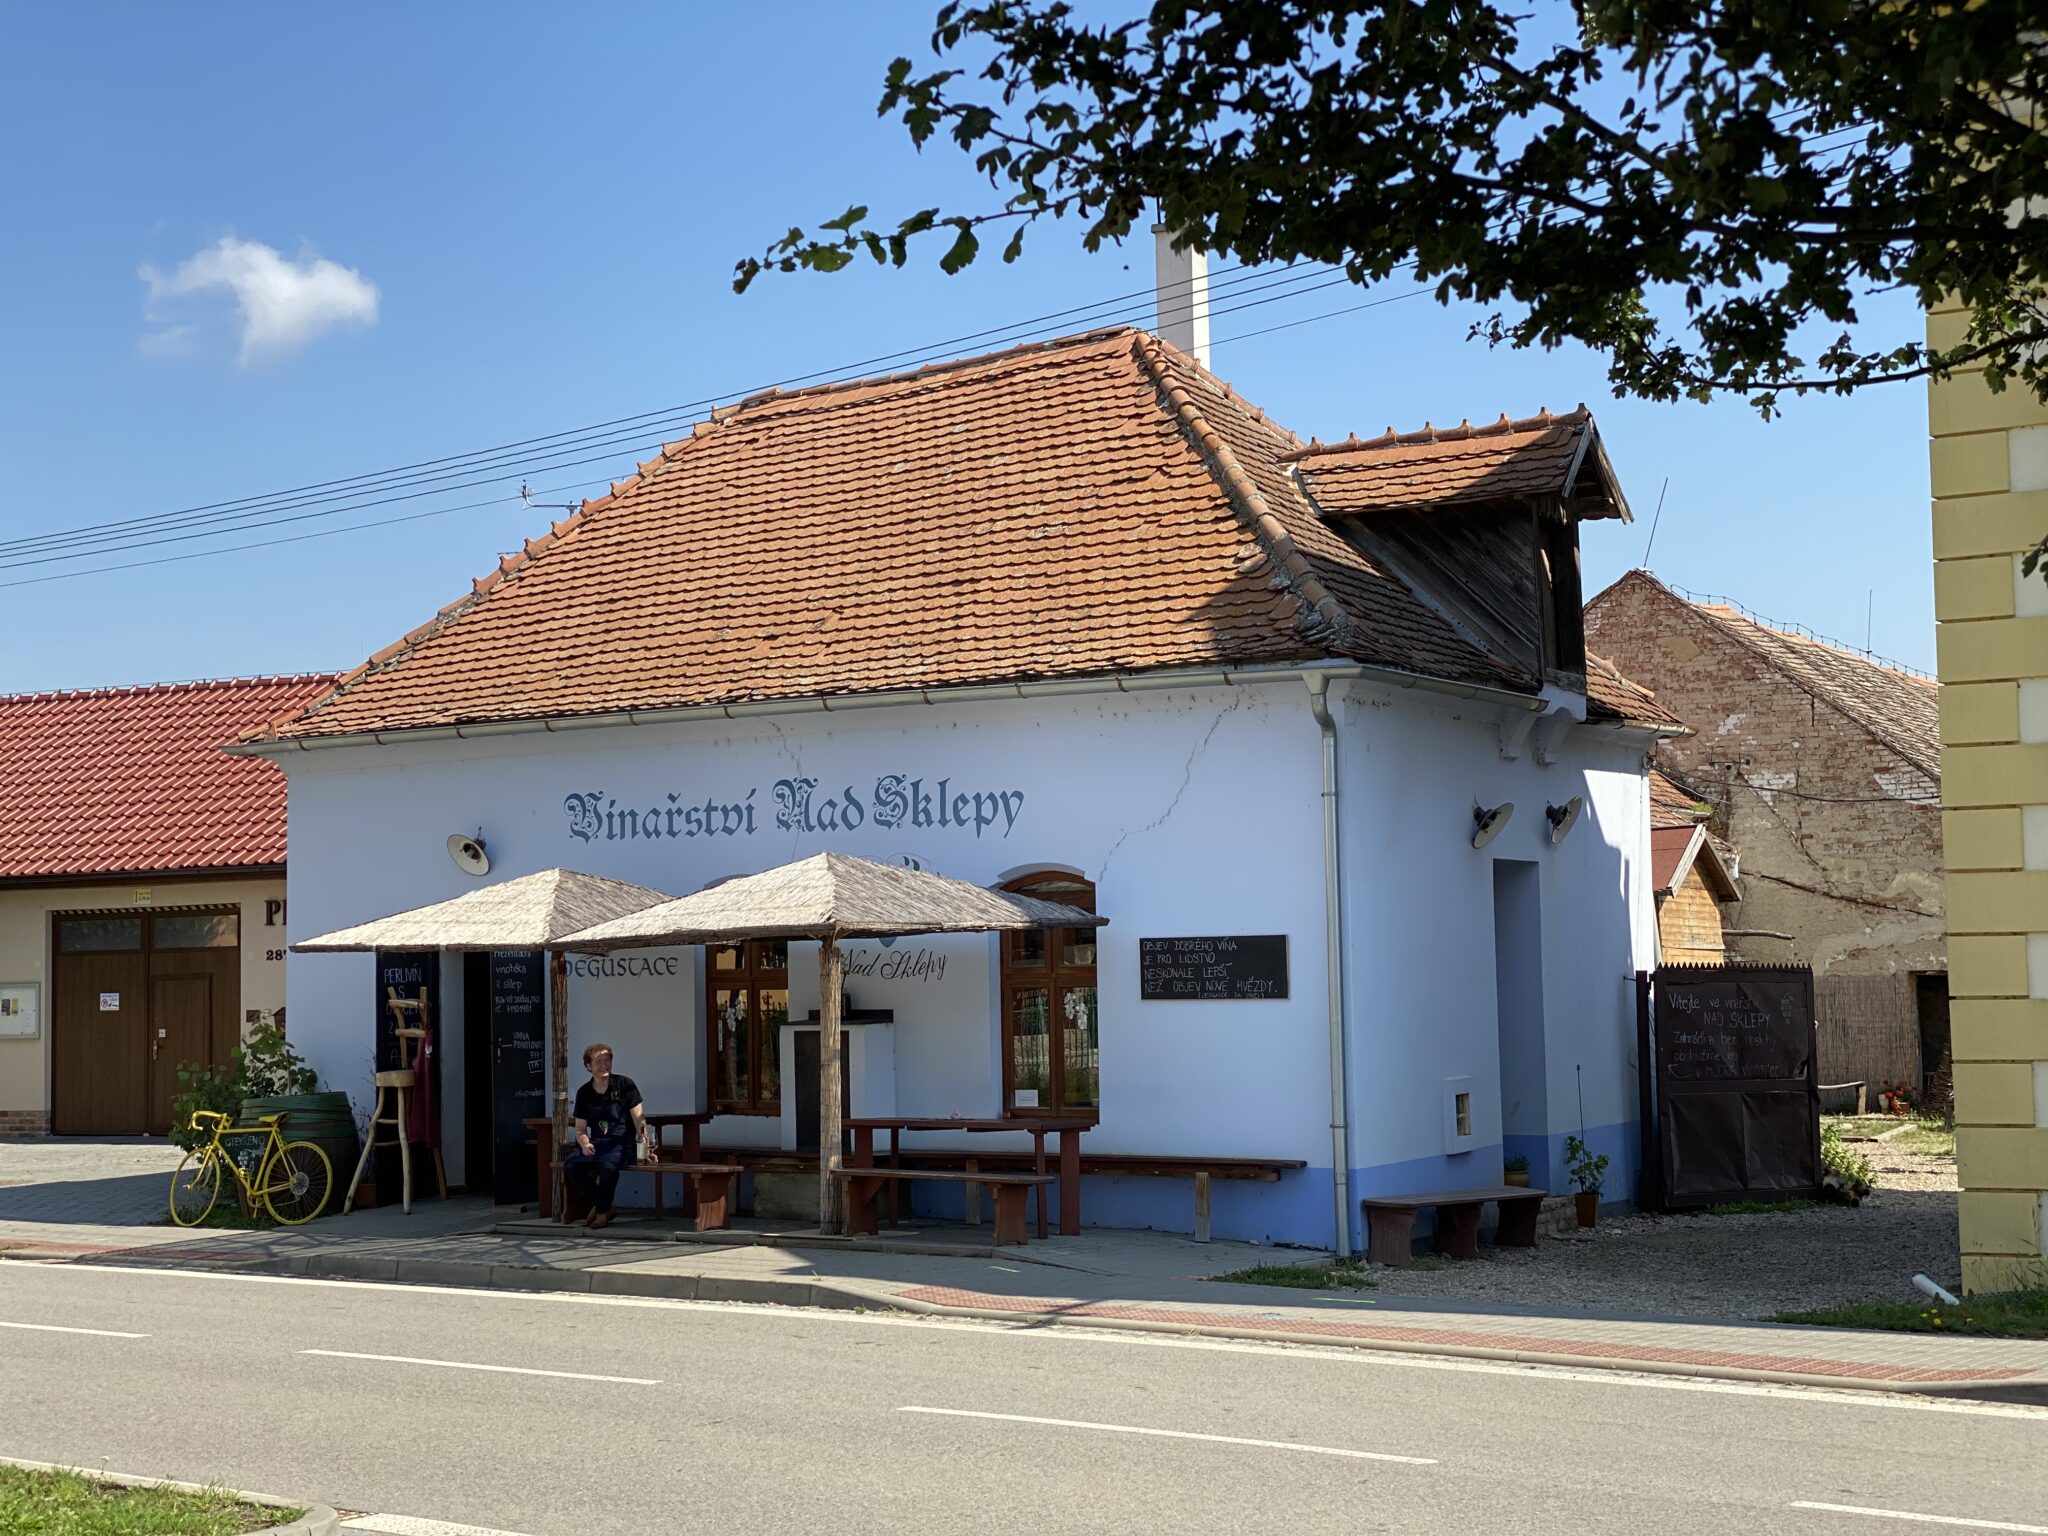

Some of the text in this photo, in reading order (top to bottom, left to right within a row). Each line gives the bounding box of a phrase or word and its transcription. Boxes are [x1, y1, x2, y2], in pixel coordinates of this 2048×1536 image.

[772, 777, 864, 832] Nad
[873, 774, 1025, 838] Sklepy
[1143, 937, 1238, 951] OBJEV DOBRÉHO VÍNA
[881, 948, 948, 982] Sklepy
[1143, 952, 1216, 965] JE PRO LIDSTVO
[1144, 963, 1233, 979] NESKONALE LEPŠÍ
[1144, 979, 1164, 993] NEŽ
[1173, 981, 1201, 993] OBJEV
[1206, 977, 1230, 992] NOVÉ
[1703, 1011, 1771, 1029] NAD SKLEPY
